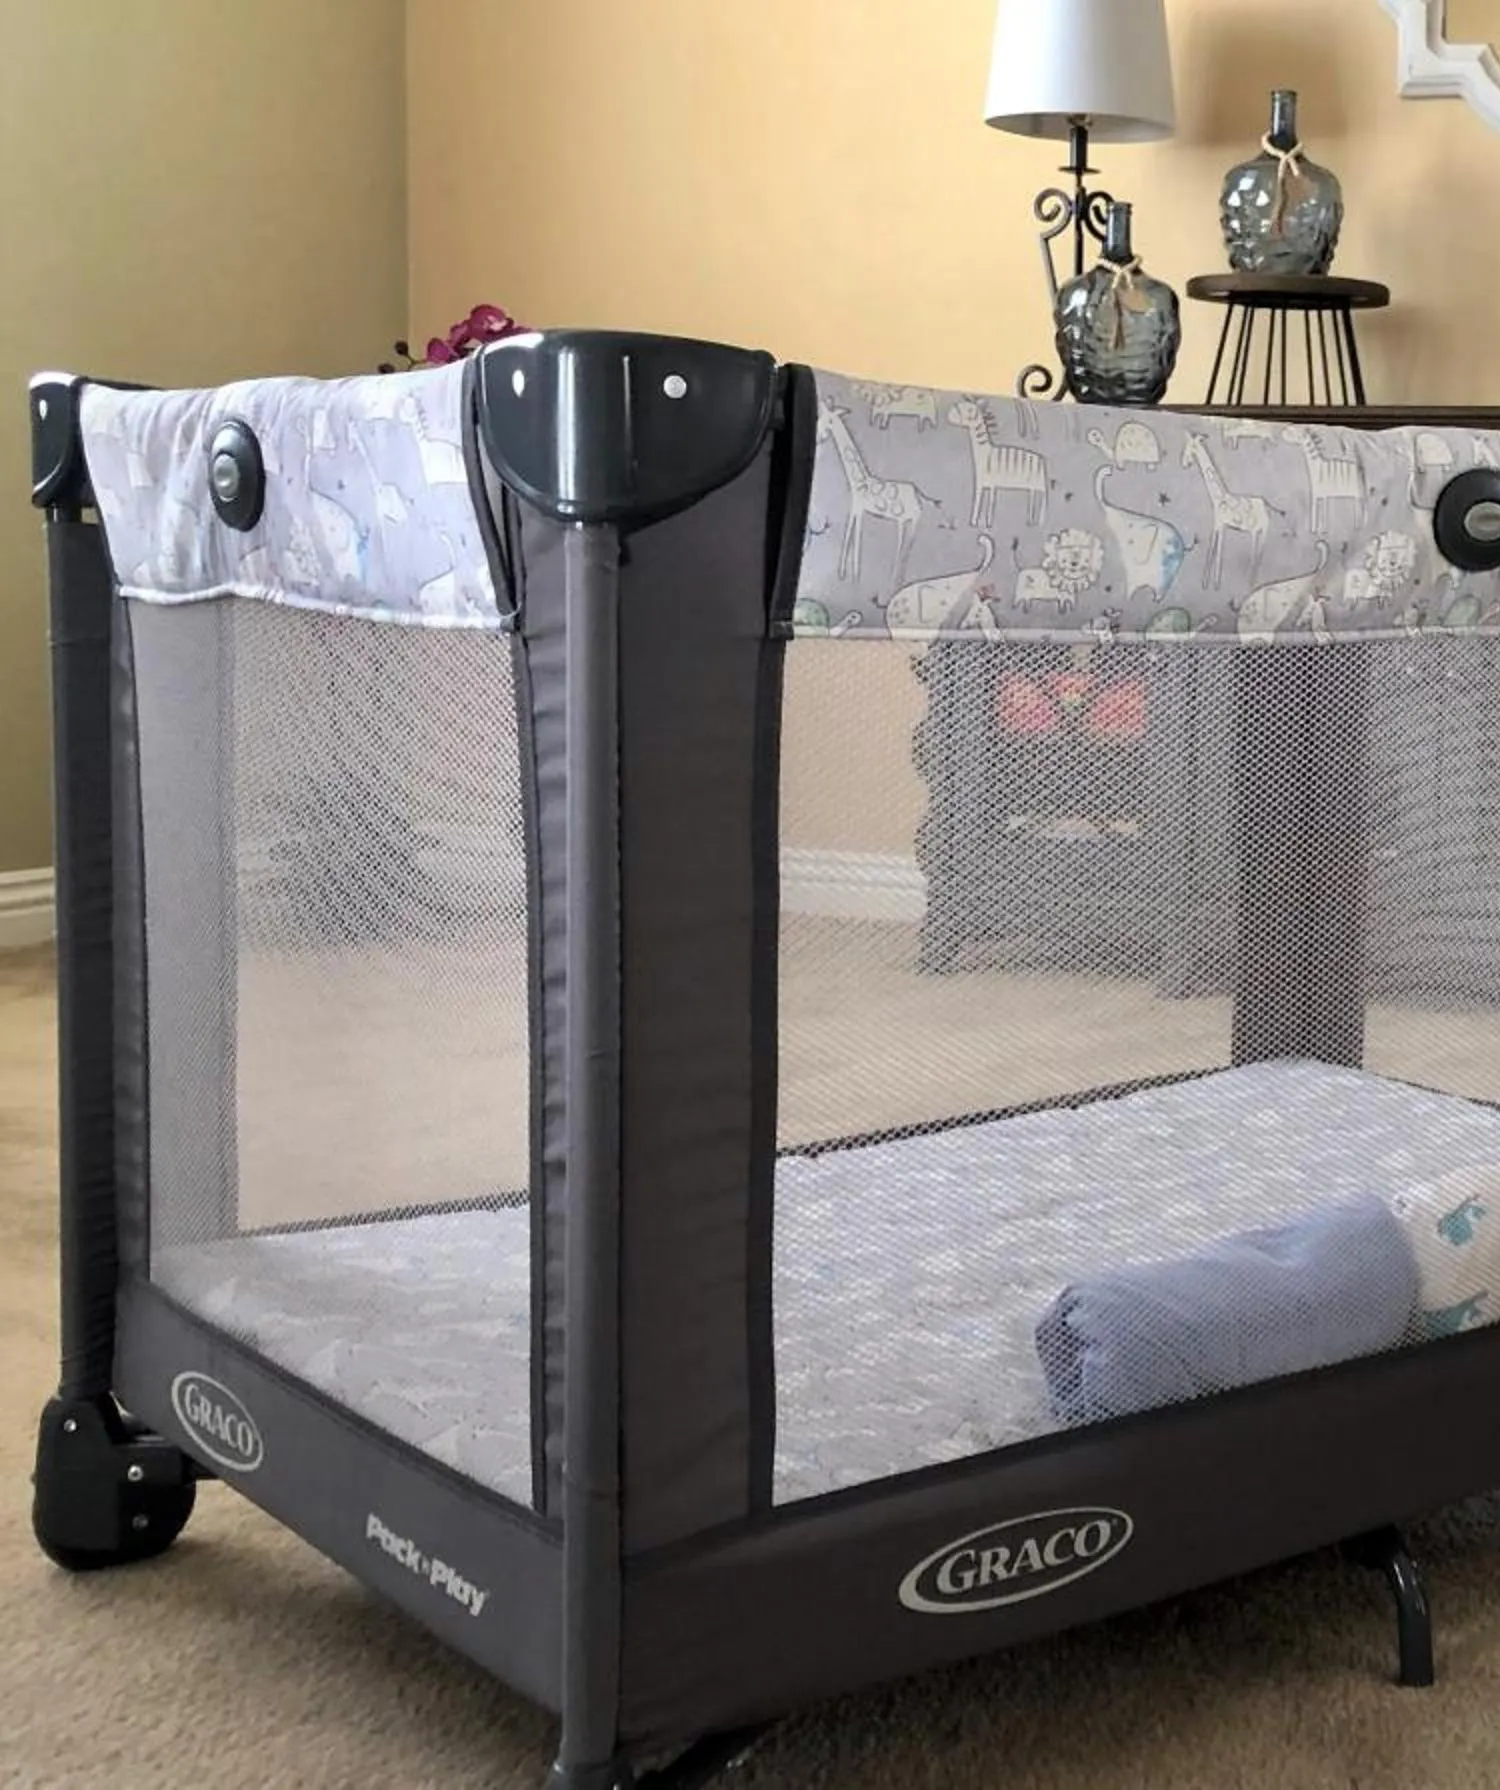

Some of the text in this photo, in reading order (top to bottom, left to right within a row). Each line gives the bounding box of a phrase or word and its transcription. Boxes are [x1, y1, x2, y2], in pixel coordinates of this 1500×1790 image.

[184, 1383, 253, 1457] GRACO
[366, 1512, 485, 1617] Pack Play
[936, 1519, 1111, 1594] GRACO
